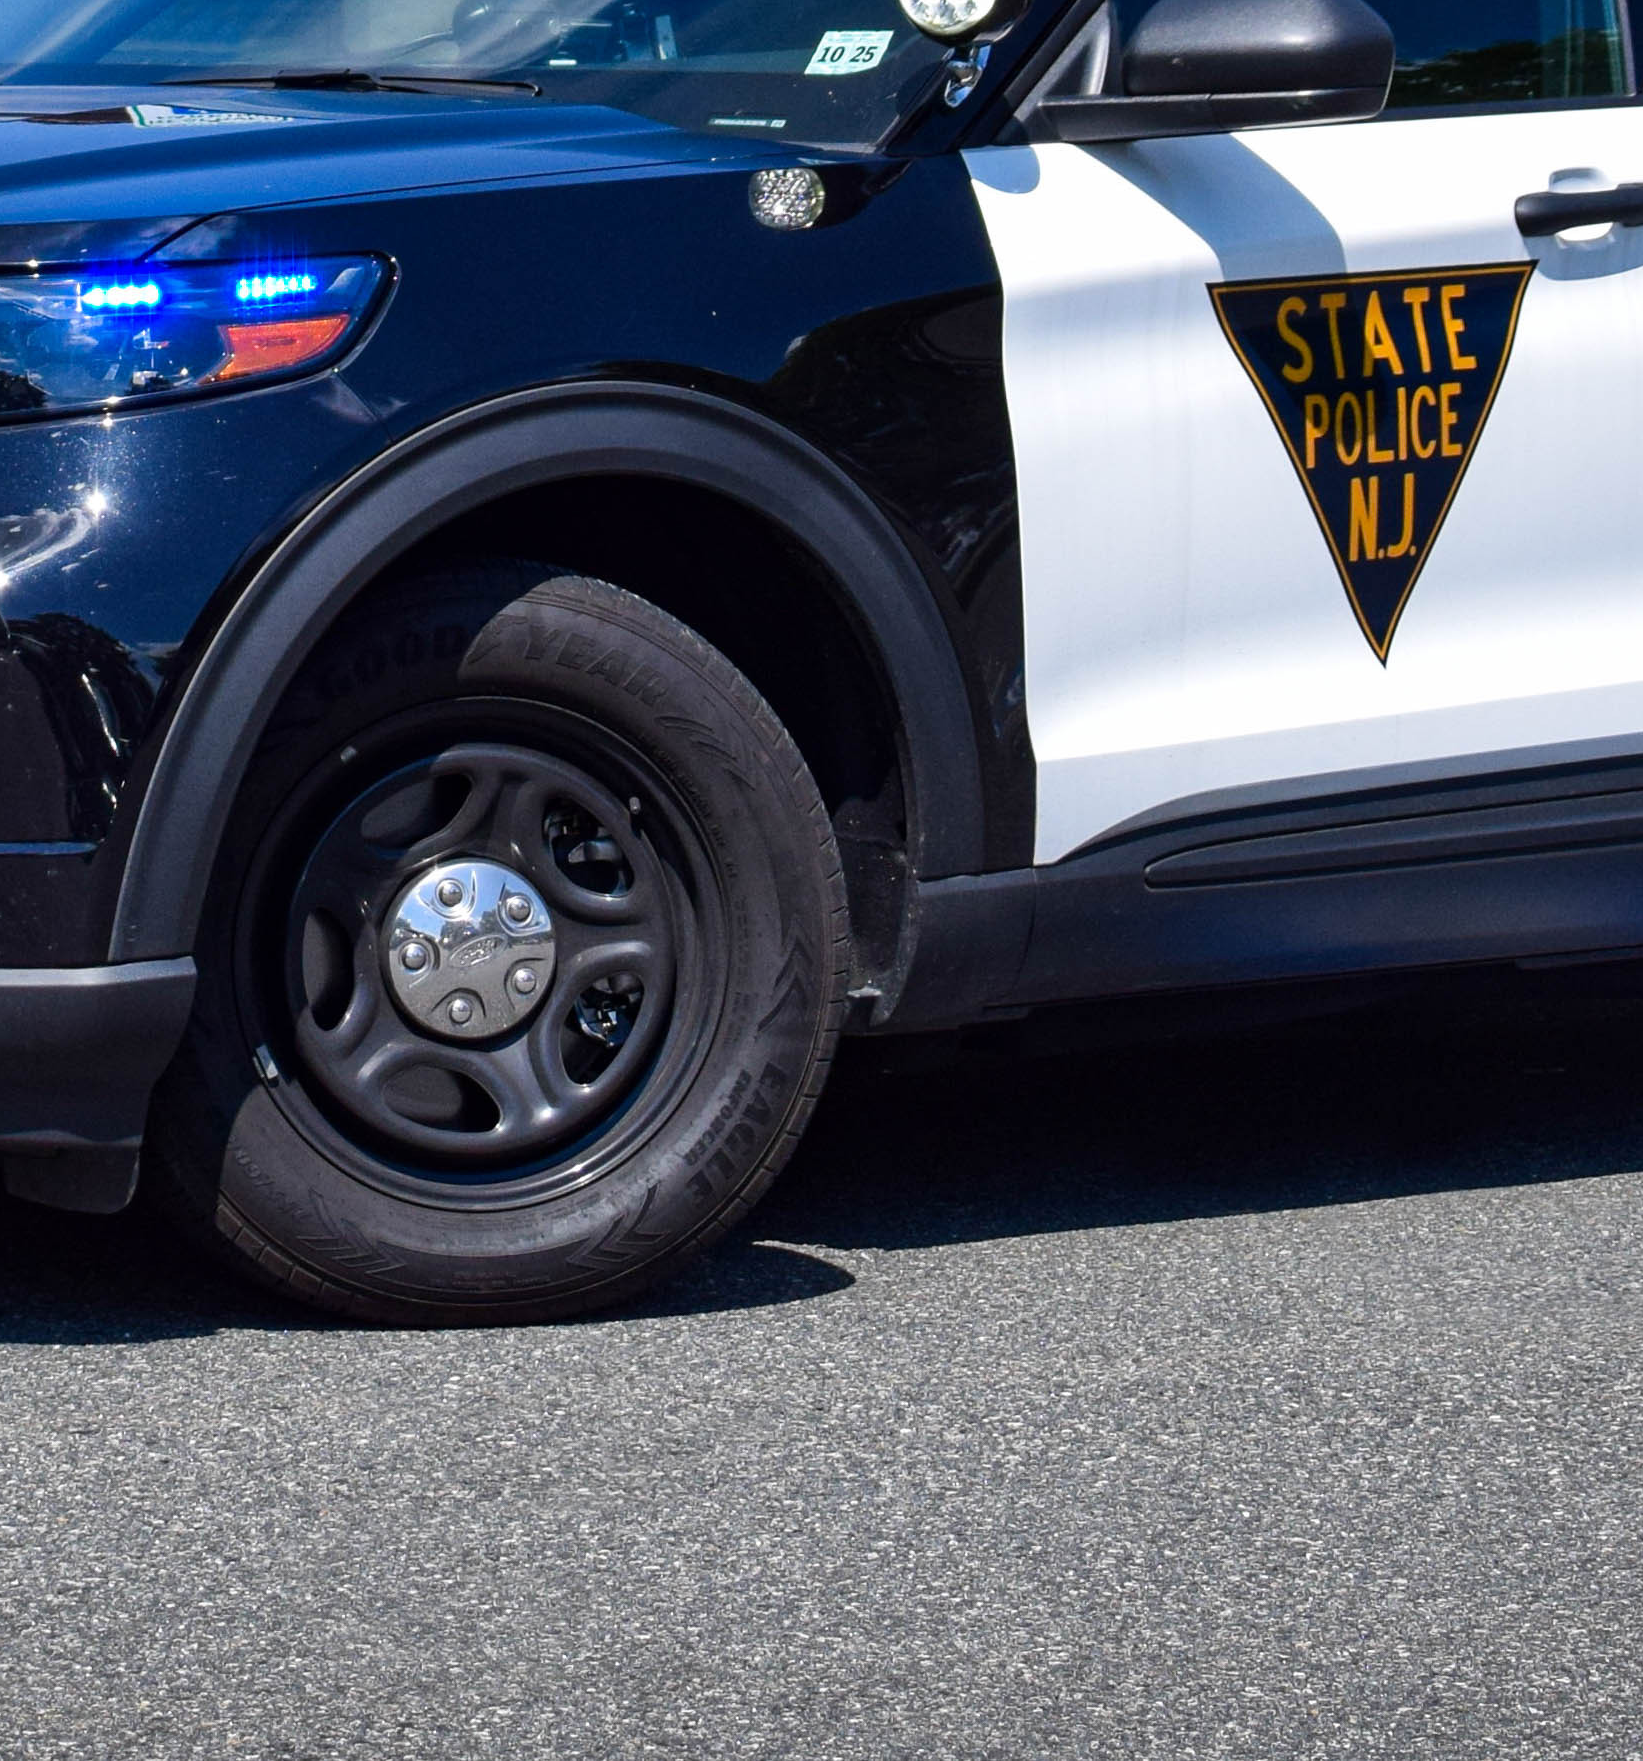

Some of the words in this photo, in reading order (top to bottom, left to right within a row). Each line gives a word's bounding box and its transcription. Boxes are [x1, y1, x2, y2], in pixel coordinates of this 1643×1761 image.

[817, 46, 845, 63] 10
[849, 46, 878, 63] 25
[1277, 284, 1477, 383] STATE
[1305, 382, 1463, 470] POLICE
[1349, 472, 1416, 562] N.J.
